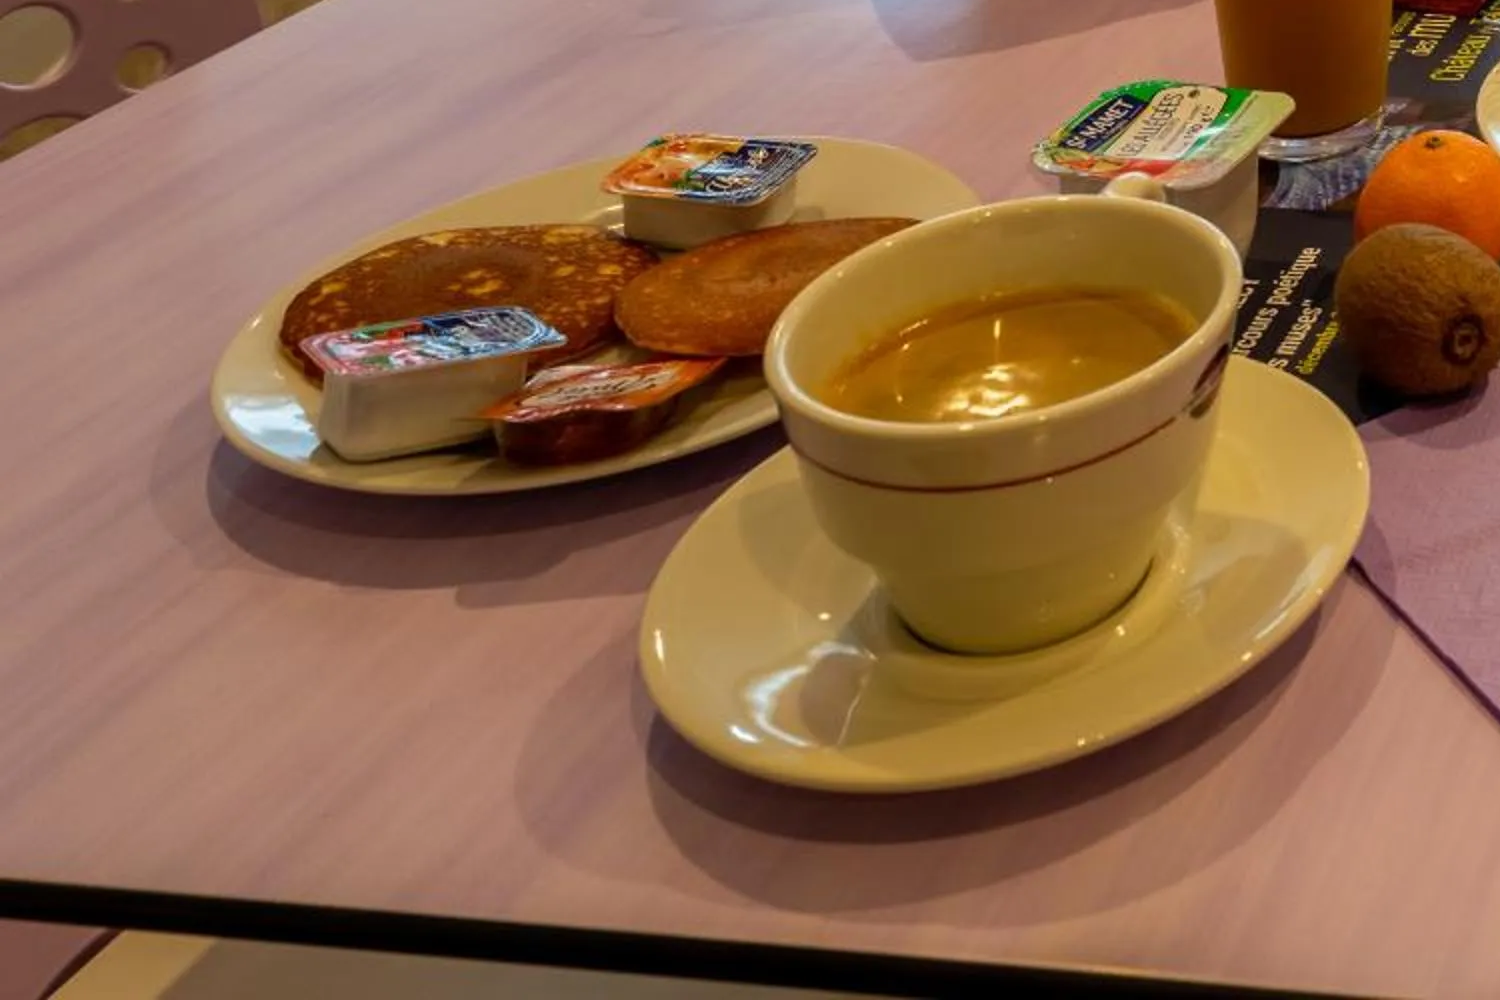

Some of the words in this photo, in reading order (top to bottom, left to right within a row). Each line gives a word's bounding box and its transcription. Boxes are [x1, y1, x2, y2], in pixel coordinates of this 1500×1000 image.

[1428, 34, 1491, 81] Château
[1084, 97, 1134, 140] MAMET
[1231, 306, 1279, 356] rcours
[1267, 247, 1322, 306] poétique
[1295, 319, 1339, 374] décembr
